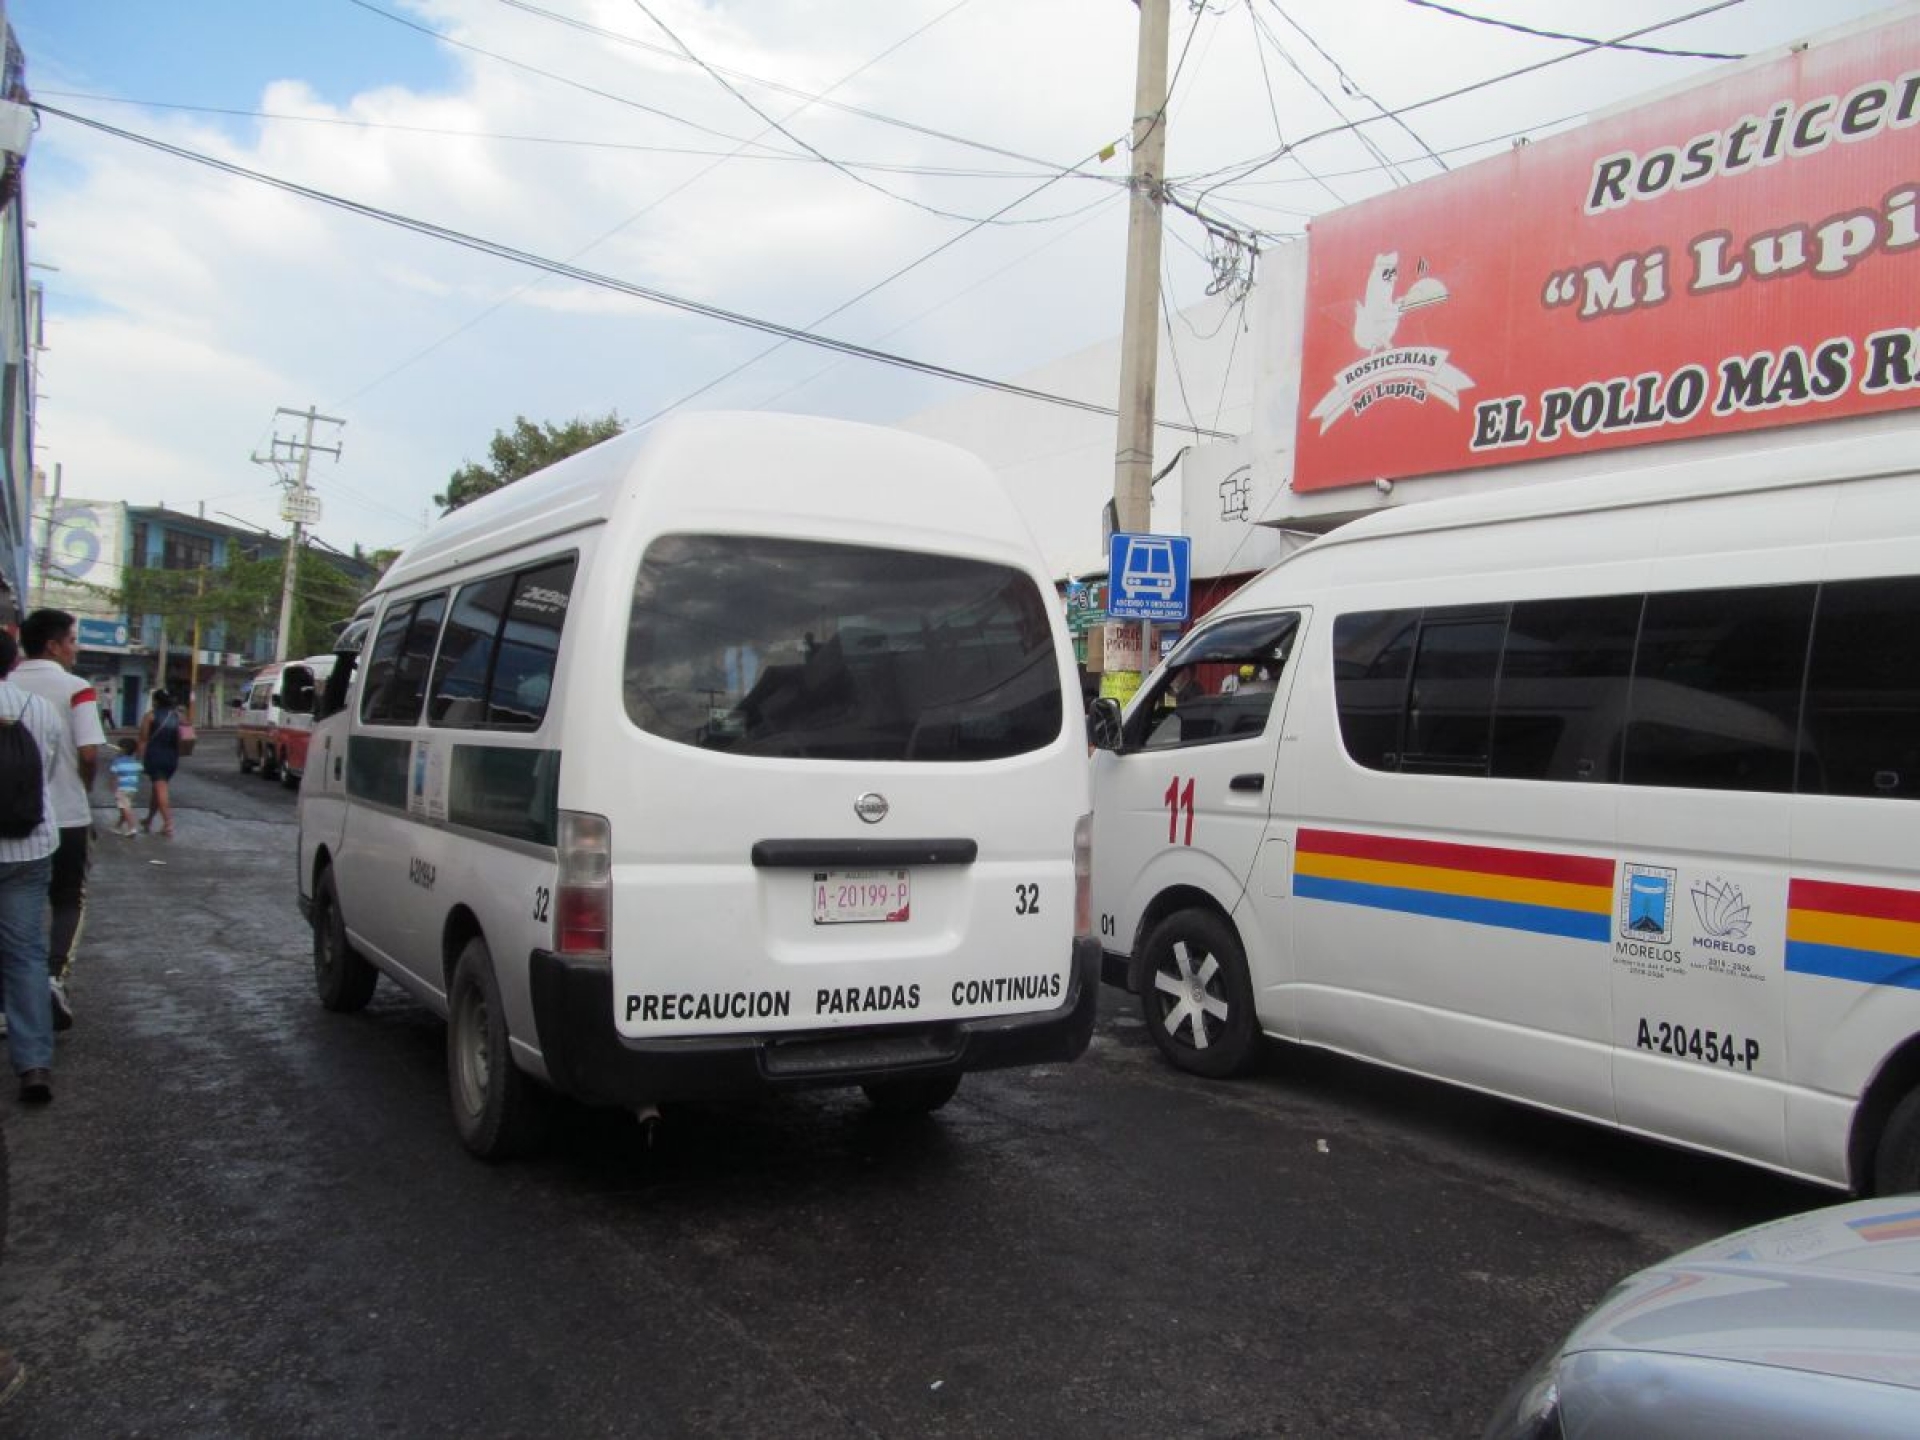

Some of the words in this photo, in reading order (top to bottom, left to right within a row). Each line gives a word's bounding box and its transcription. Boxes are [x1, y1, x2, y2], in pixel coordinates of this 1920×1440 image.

[1692, 190, 1920, 290] Lupi
[1344, 351, 1438, 385] ROSTICERIAS
[1353, 389, 1372, 413] Mi
[1375, 380, 1427, 401] Lupita
[1473, 399, 1529, 447] EL
[1541, 369, 1705, 438] POLLO
[1716, 342, 1850, 412] MAS
[1864, 333, 1920, 389] R
[1164, 776, 1195, 846] 11
[533, 885, 550, 923] 32
[817, 882, 908, 910] A-20199-P
[1015, 883, 1040, 915] 32
[1101, 914, 1115, 936] 01
[1615, 941, 1682, 964] MORELOS
[1692, 936, 1756, 956] MORELOS
[626, 990, 791, 1021] PRECAUCION
[816, 984, 921, 1014] PARADAS
[951, 973, 1062, 1007] CONTINUAS
[1636, 1016, 1761, 1071] A-20454-P
